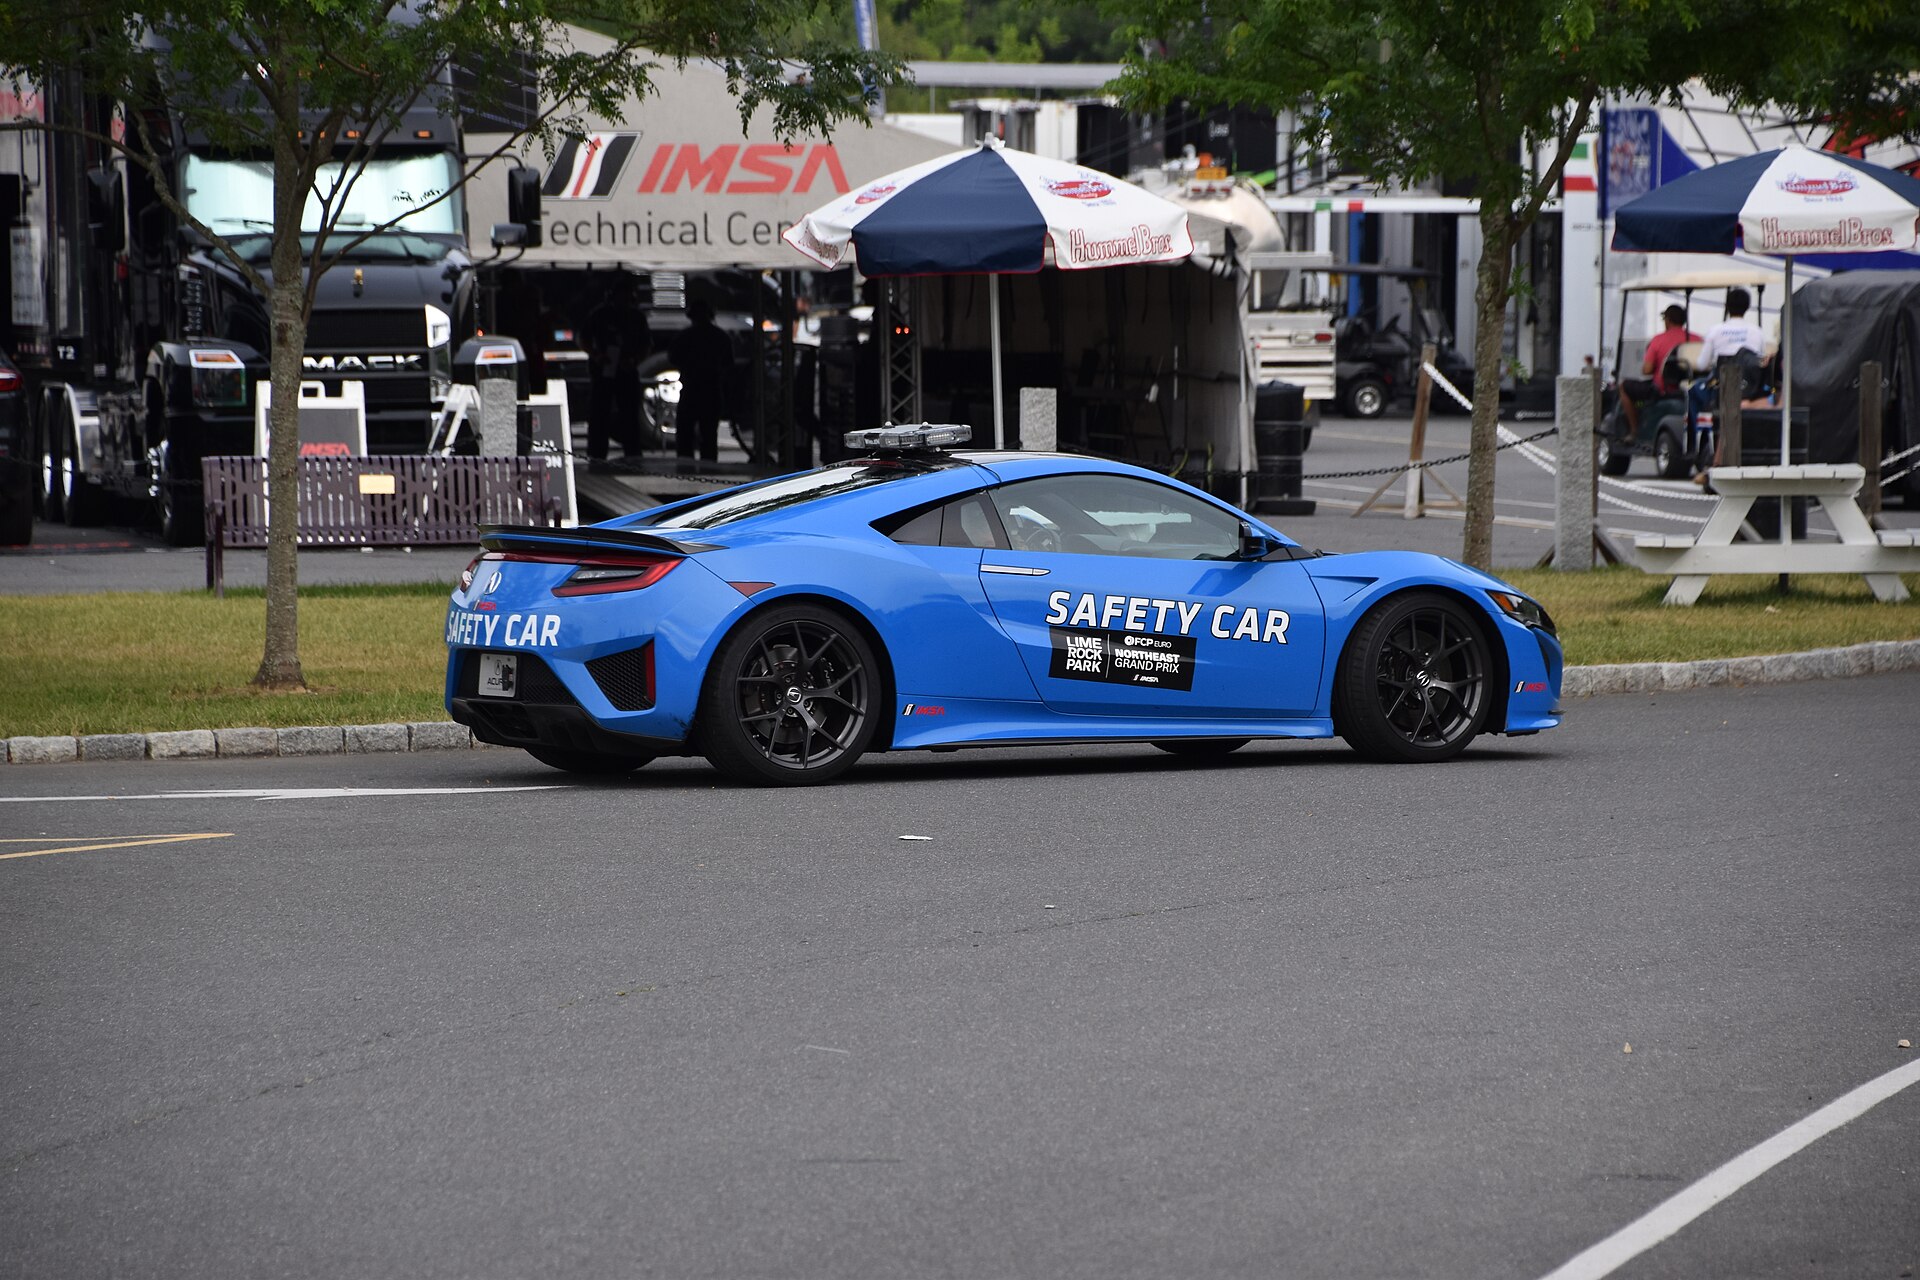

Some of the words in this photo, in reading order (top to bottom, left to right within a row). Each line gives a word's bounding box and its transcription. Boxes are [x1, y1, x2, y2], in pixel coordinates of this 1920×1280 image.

[637, 143, 850, 194] IMSA
[541, 210, 712, 246] echnical
[1761, 217, 1846, 249] Hummel
[1069, 226, 1141, 263] Hummel
[57, 346, 75, 360] T2
[302, 355, 423, 371] MACK
[1045, 590, 1203, 635] SAFETY
[1210, 604, 1290, 644] CAR
[446, 610, 500, 646] SAFETY
[504, 613, 561, 647] CAR
[1066, 636, 1102, 649] LIME
[1154, 640, 1172, 648] EURO
[1067, 647, 1102, 660] ROCK
[1114, 648, 1180, 663] NORTHEAST
[1066, 659, 1101, 673] PARK
[1114, 658, 1153, 671] GRAND
[1155, 662, 1180, 673] PRIX
[487, 677, 503, 686] ACUR
[915, 706, 945, 716] IMSA
